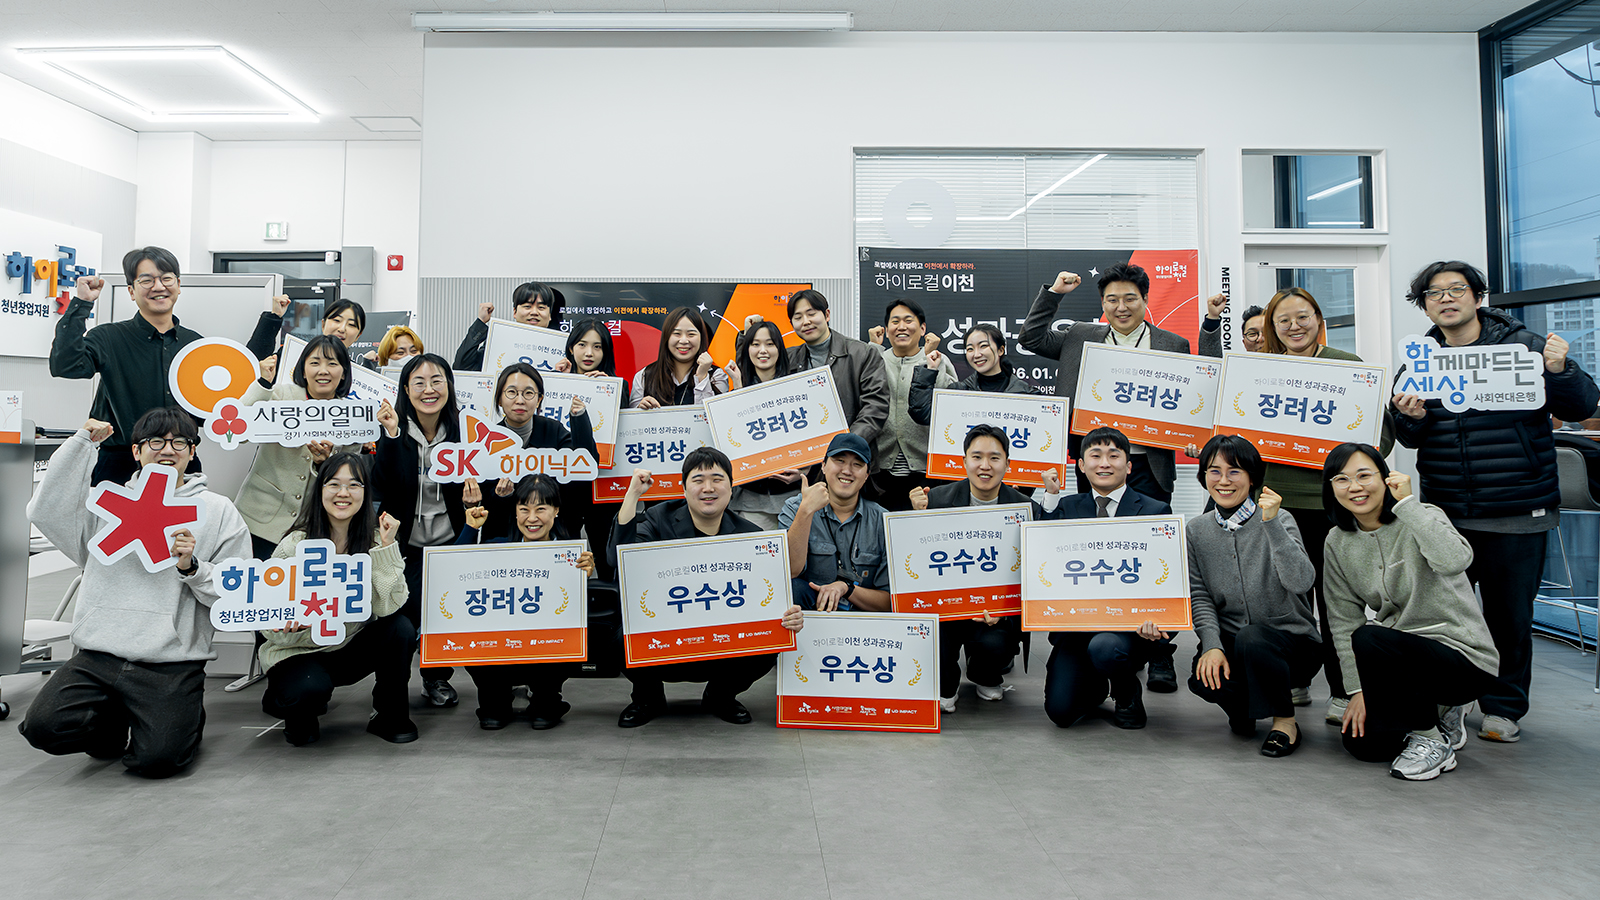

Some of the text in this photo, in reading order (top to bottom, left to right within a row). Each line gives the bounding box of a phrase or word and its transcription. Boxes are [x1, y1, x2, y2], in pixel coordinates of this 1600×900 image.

[874, 261, 898, 269] 로컬에서
[899, 261, 924, 270] 창업하고
[924, 262, 949, 270] 이천에서
[1, 299, 49, 318] 청년창업지원
[559, 306, 585, 314] 로컬에서
[586, 306, 612, 314] 창업하고
[613, 306, 640, 314] 이천에서
[559, 319, 622, 336] 하컬
[1222, 317, 1231, 350] ROOM
[1113, 381, 1182, 410] 장려상
[1304, 381, 1347, 396] 성과공유회
[1401, 375, 1468, 406] 세상
[1474, 391, 1537, 403] 사회연대은행
[253, 405, 374, 429] 사랑의열매
[1257, 393, 1337, 425] 장려상
[284, 429, 375, 440] 경기 사회복지공동모금회
[746, 407, 808, 441] 장려상
[435, 448, 592, 477] SK 하이닉스
[625, 439, 687, 464] 장려상
[1105, 541, 1148, 551] 성과공유회
[709, 561, 752, 572] 성과공유회
[928, 545, 999, 576] 우수상
[1063, 557, 1142, 585] 우수상
[508, 568, 550, 579] 성과공유회
[464, 585, 543, 616] 장려상
[666, 578, 748, 614] 우수상
[219, 607, 296, 624] 청년창업지원
[862, 637, 903, 650] 성과공유회
[819, 655, 897, 684] 우수상
